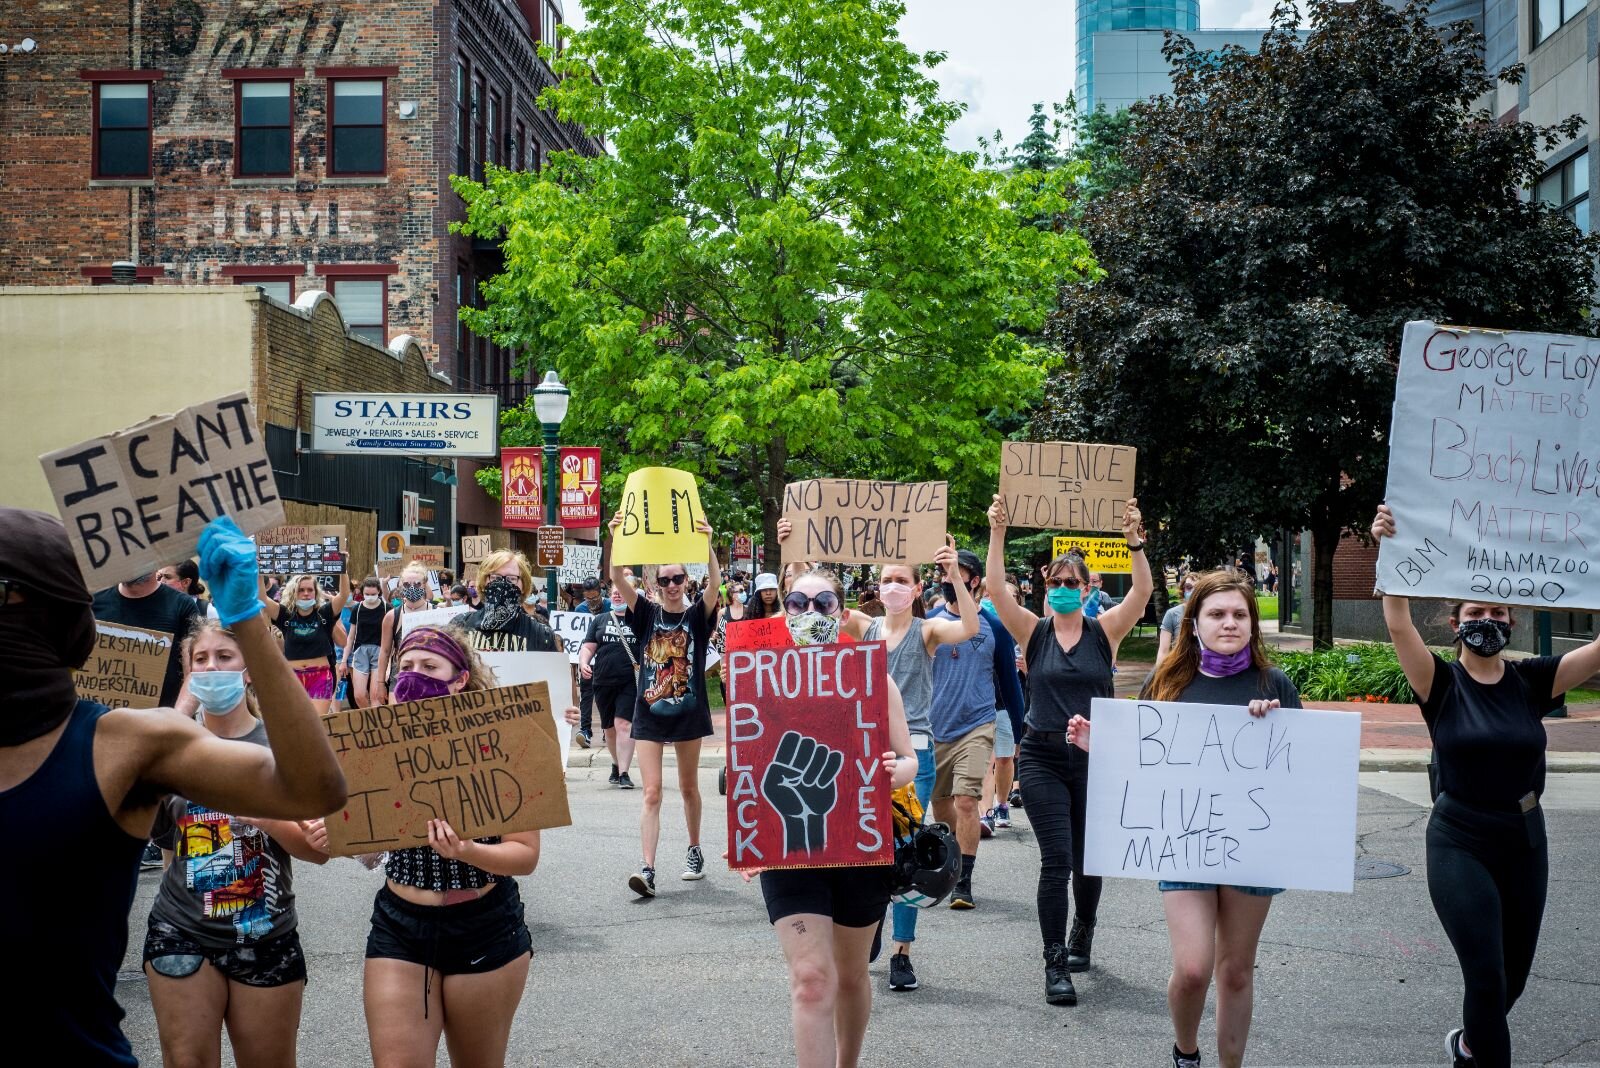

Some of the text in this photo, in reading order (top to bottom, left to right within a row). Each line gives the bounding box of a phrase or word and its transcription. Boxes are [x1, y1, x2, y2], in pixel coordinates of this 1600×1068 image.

[1423, 330, 1600, 390] George FLOY
[334, 400, 472, 420] STAHRS
[1457, 382, 1590, 419] MATTERS
[324, 429, 479, 439] JEWELRY REPAIRS SALES SERVICE
[365, 418, 438, 427] of Kalamazoo
[55, 397, 254, 508] I CANT
[359, 440, 382, 449] Family
[1005, 442, 1129, 482] SILENCE
[1429, 416, 1526, 497] Black
[786, 480, 947, 514] NO JUSTICE
[1058, 480, 1083, 493] IS
[75, 459, 277, 570] BREATHE
[504, 505, 541, 516] CENTRAL CITY
[623, 487, 695, 537] BLM
[1004, 494, 1127, 531] VIOLENCE
[1449, 498, 1588, 550] MATTER
[463, 537, 490, 558] BLM
[571, 547, 601, 559] JUSTICE
[807, 516, 910, 559] NO PEACE
[1056, 540, 1090, 548] PROTECT
[571, 559, 595, 570] PEACE
[1394, 537, 1590, 587] BLM KALAMAZOO
[1470, 574, 1565, 603] 2020
[554, 613, 566, 632] I
[97, 658, 141, 679] WILL
[729, 644, 881, 701] PROTECT
[323, 683, 533, 737] I UNDERSTAND THAT
[333, 700, 545, 753] I WILL NEVER UNDERSTAND.
[394, 728, 511, 781] HOWEVER,
[1137, 704, 1292, 774] BLACK
[729, 702, 765, 862] BLACK
[855, 700, 883, 853] LIVES
[346, 767, 523, 846] I STAND
[1120, 779, 1271, 833] LIVES
[1122, 828, 1241, 872] MATTER
